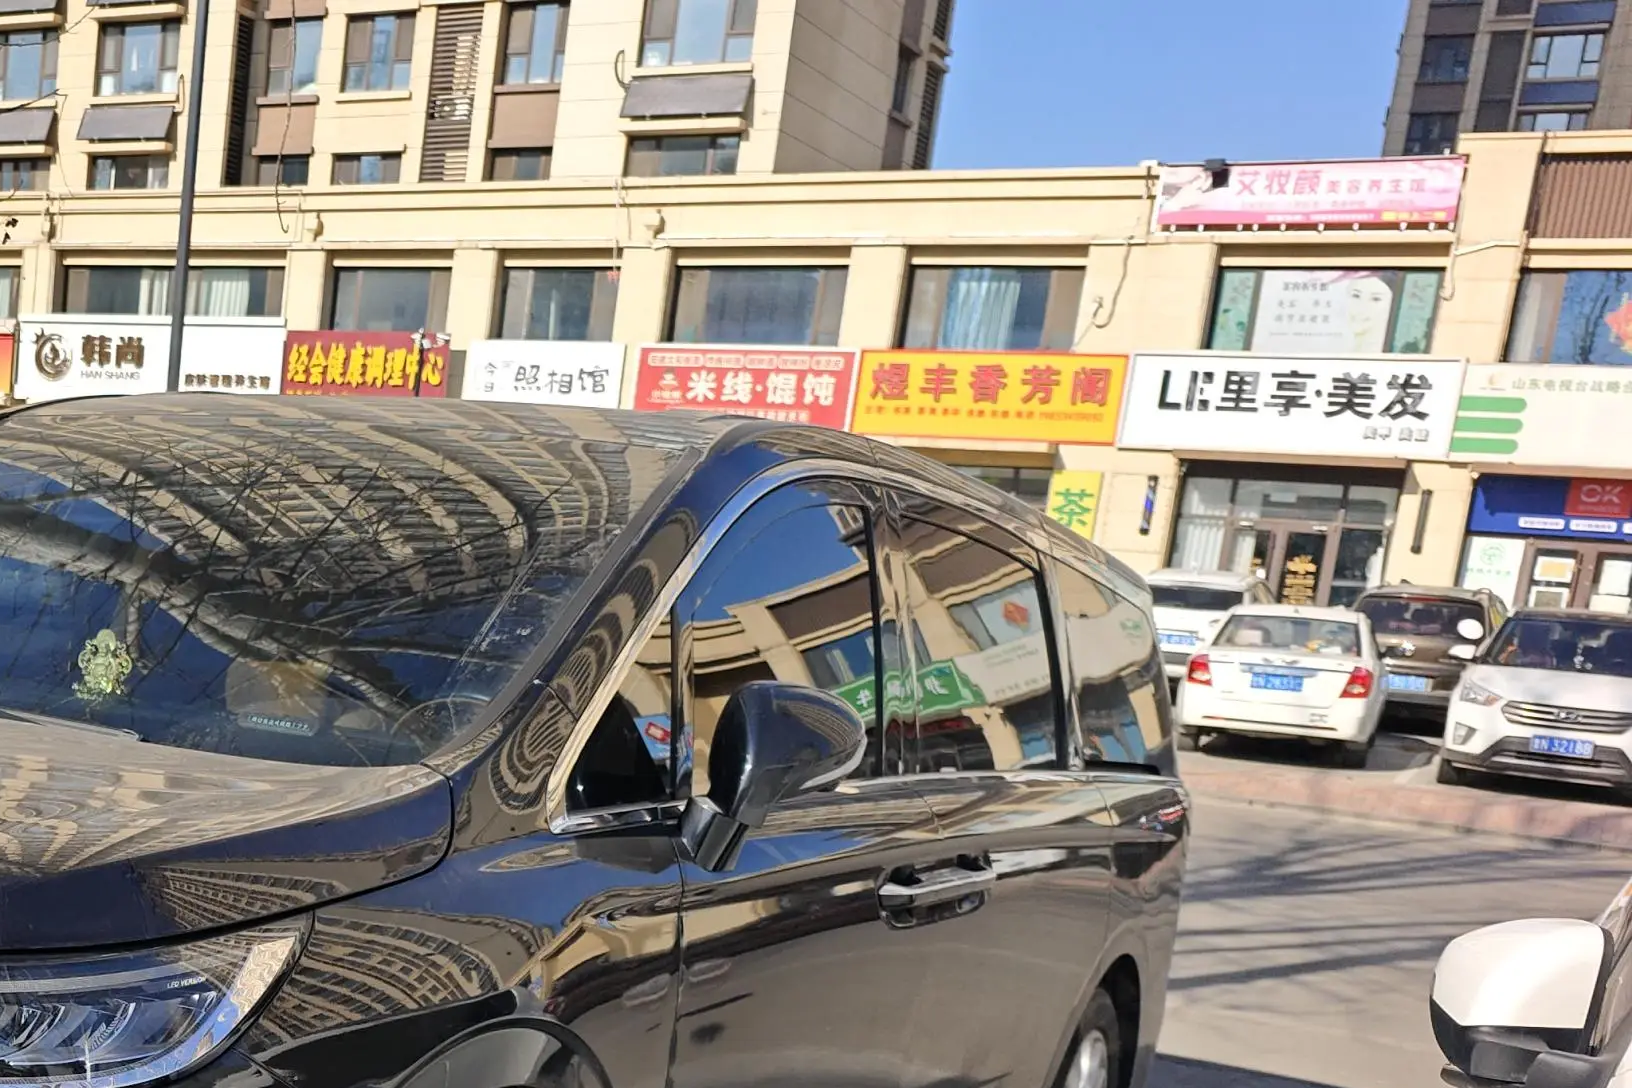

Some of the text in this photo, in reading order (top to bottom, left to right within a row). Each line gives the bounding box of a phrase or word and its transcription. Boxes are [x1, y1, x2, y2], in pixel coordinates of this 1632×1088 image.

[80, 334, 145, 369] 韩尚
[80, 370, 141, 381] HAN SHANG
[513, 364, 609, 395] 照相馆
[1051, 487, 1095, 529] 茶
[1579, 483, 1624, 504] OK
